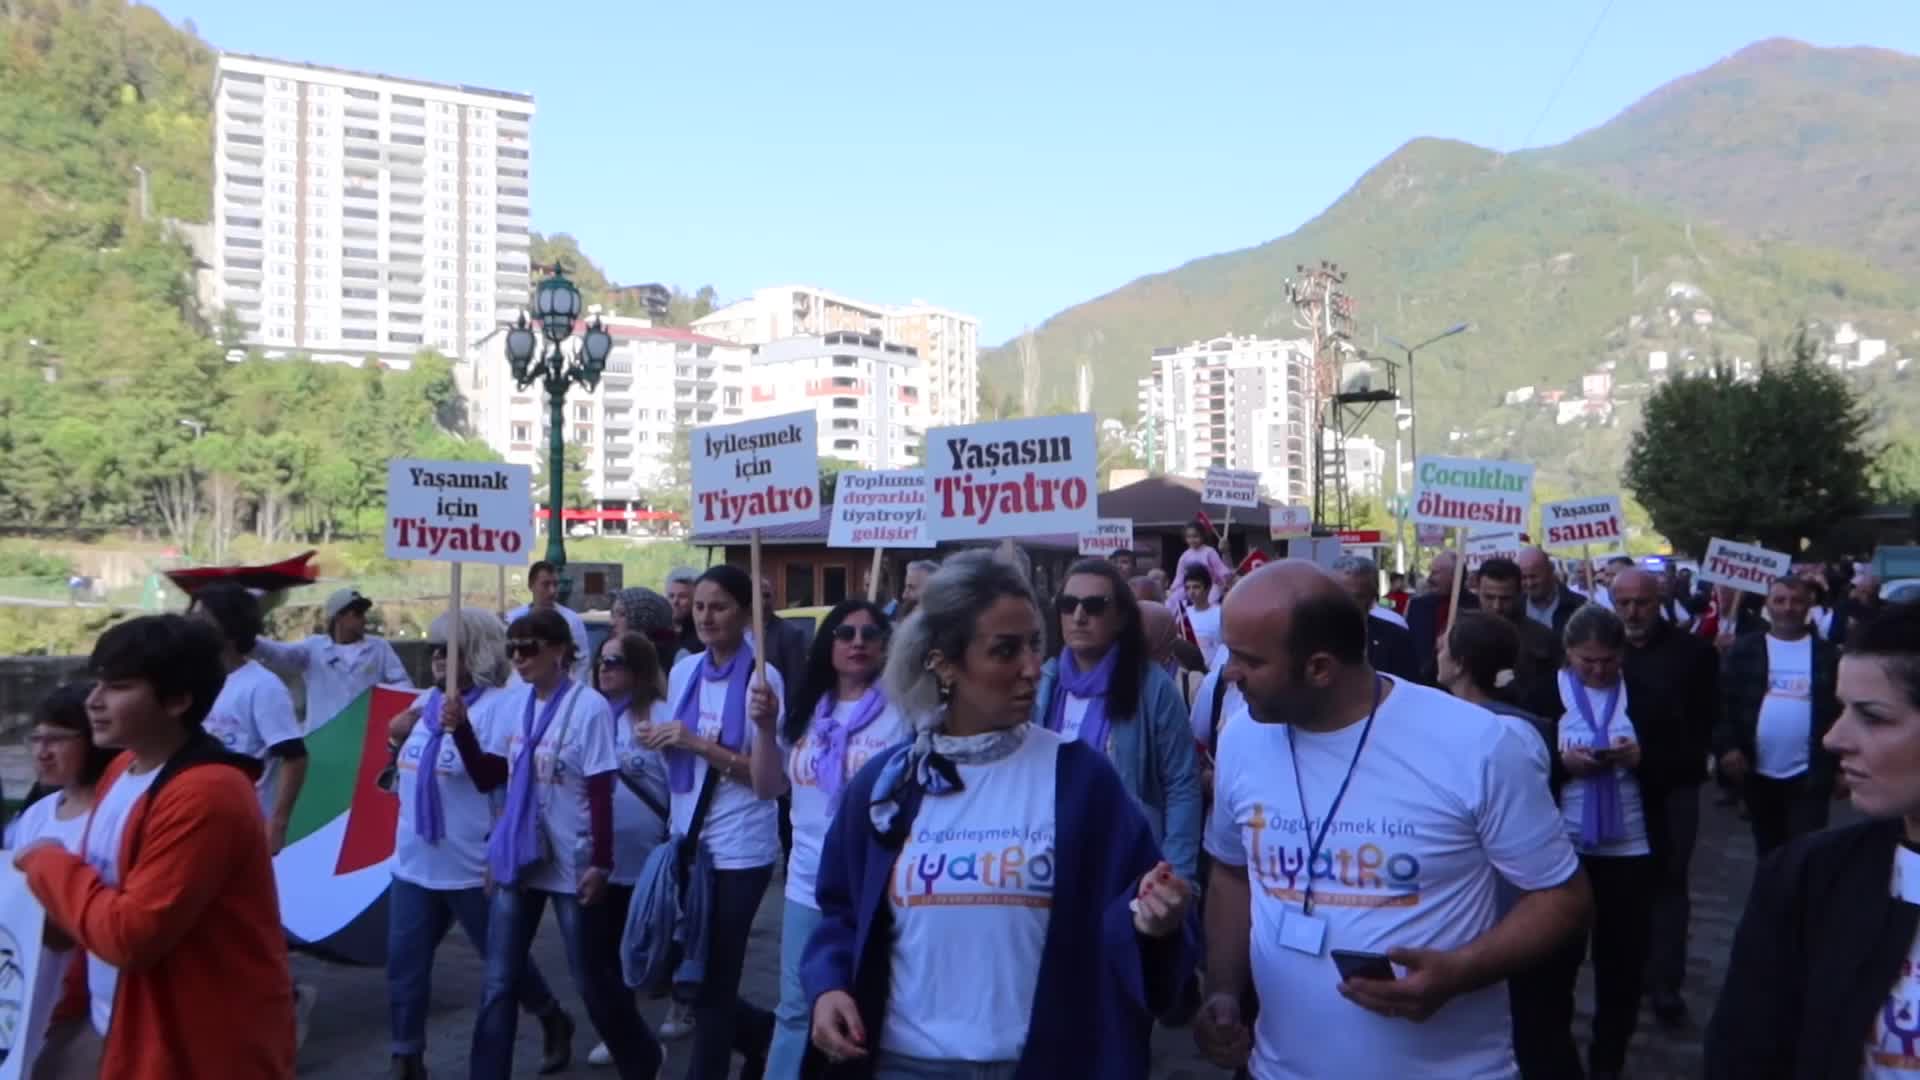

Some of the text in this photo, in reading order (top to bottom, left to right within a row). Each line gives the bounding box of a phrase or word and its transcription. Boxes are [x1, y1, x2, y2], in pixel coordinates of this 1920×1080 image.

[705, 424, 803, 461] İyileşmek
[947, 436, 1072, 476] Yaşasın
[409, 467, 509, 492] Yaşamak
[735, 455, 772, 483] için
[842, 475, 925, 490] Toplums
[1420, 463, 1528, 492] Çocuklar
[698, 484, 814, 525] Tiyatro
[842, 490, 927, 506] duyarlılı
[934, 472, 1088, 525] Tiyatro
[1206, 488, 1223, 499] ya
[1416, 490, 1522, 525] ölmesin
[436, 496, 478, 522] için
[1551, 503, 1611, 520] Yaşasın
[392, 517, 522, 556] Tiyatro
[1548, 515, 1620, 543] sanat
